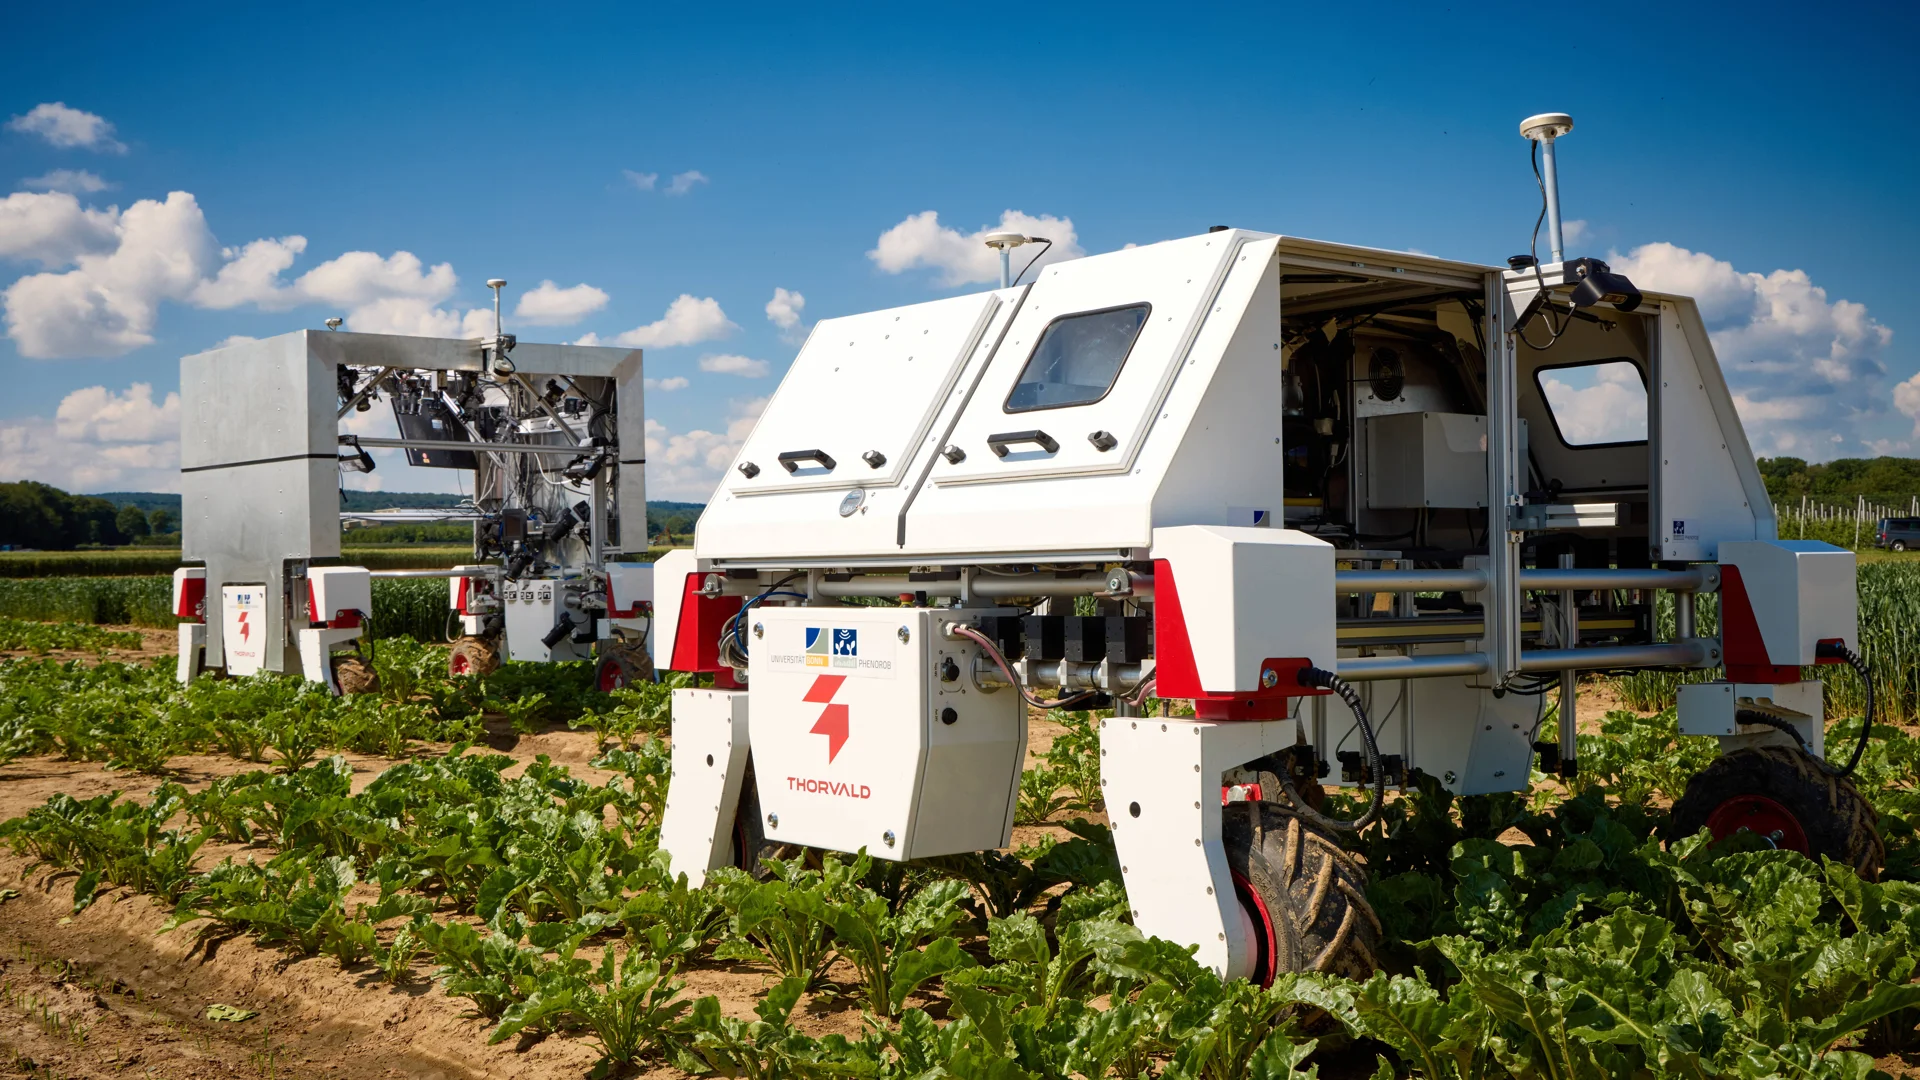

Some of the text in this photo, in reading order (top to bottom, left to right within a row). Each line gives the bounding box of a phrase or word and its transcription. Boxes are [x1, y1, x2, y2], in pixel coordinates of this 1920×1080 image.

[770, 654, 892, 669] UNIVERSITÄT BONN PHENOROB
[786, 776, 871, 799] THORVALD
